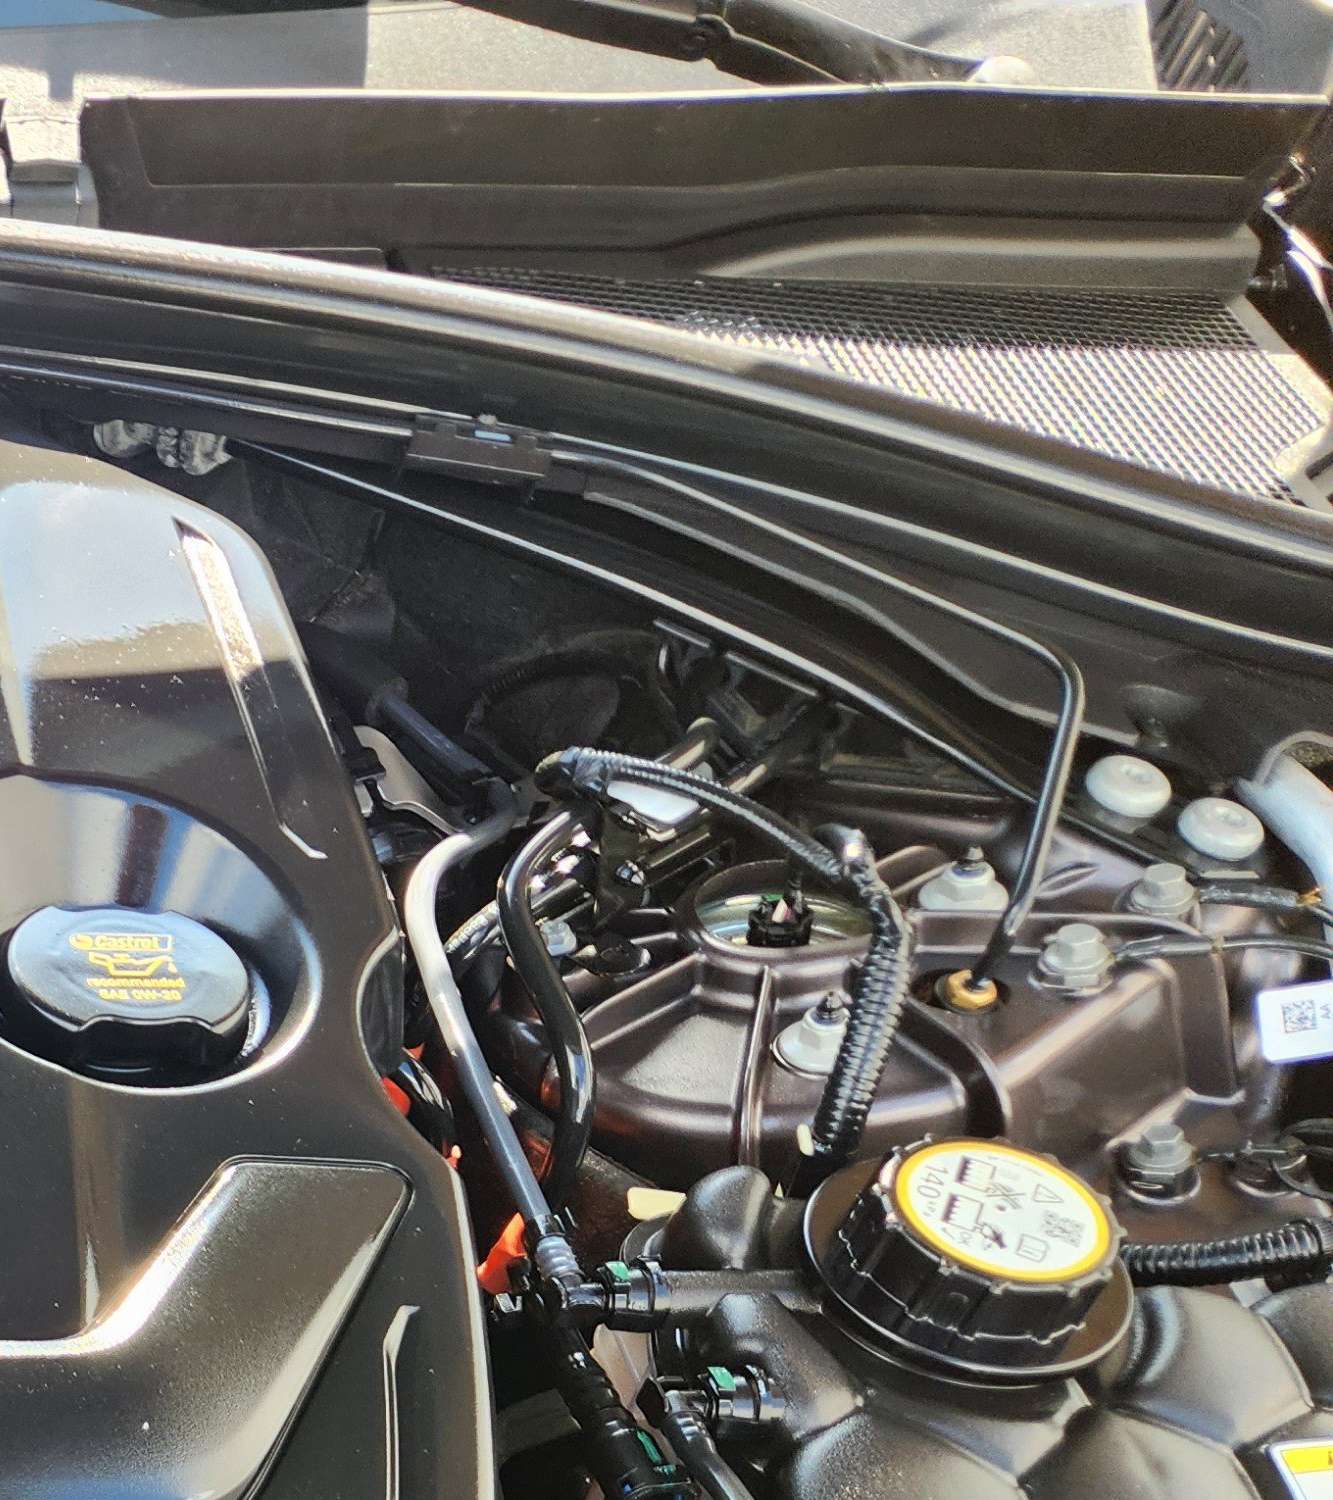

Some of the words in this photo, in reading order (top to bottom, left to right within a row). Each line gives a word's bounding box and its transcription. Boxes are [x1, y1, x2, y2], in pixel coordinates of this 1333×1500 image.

[94, 934, 160, 949] Castrol
[86, 977, 186, 988] recommended
[98, 988, 130, 1000] SAE
[916, 1164, 950, 1200] 140
